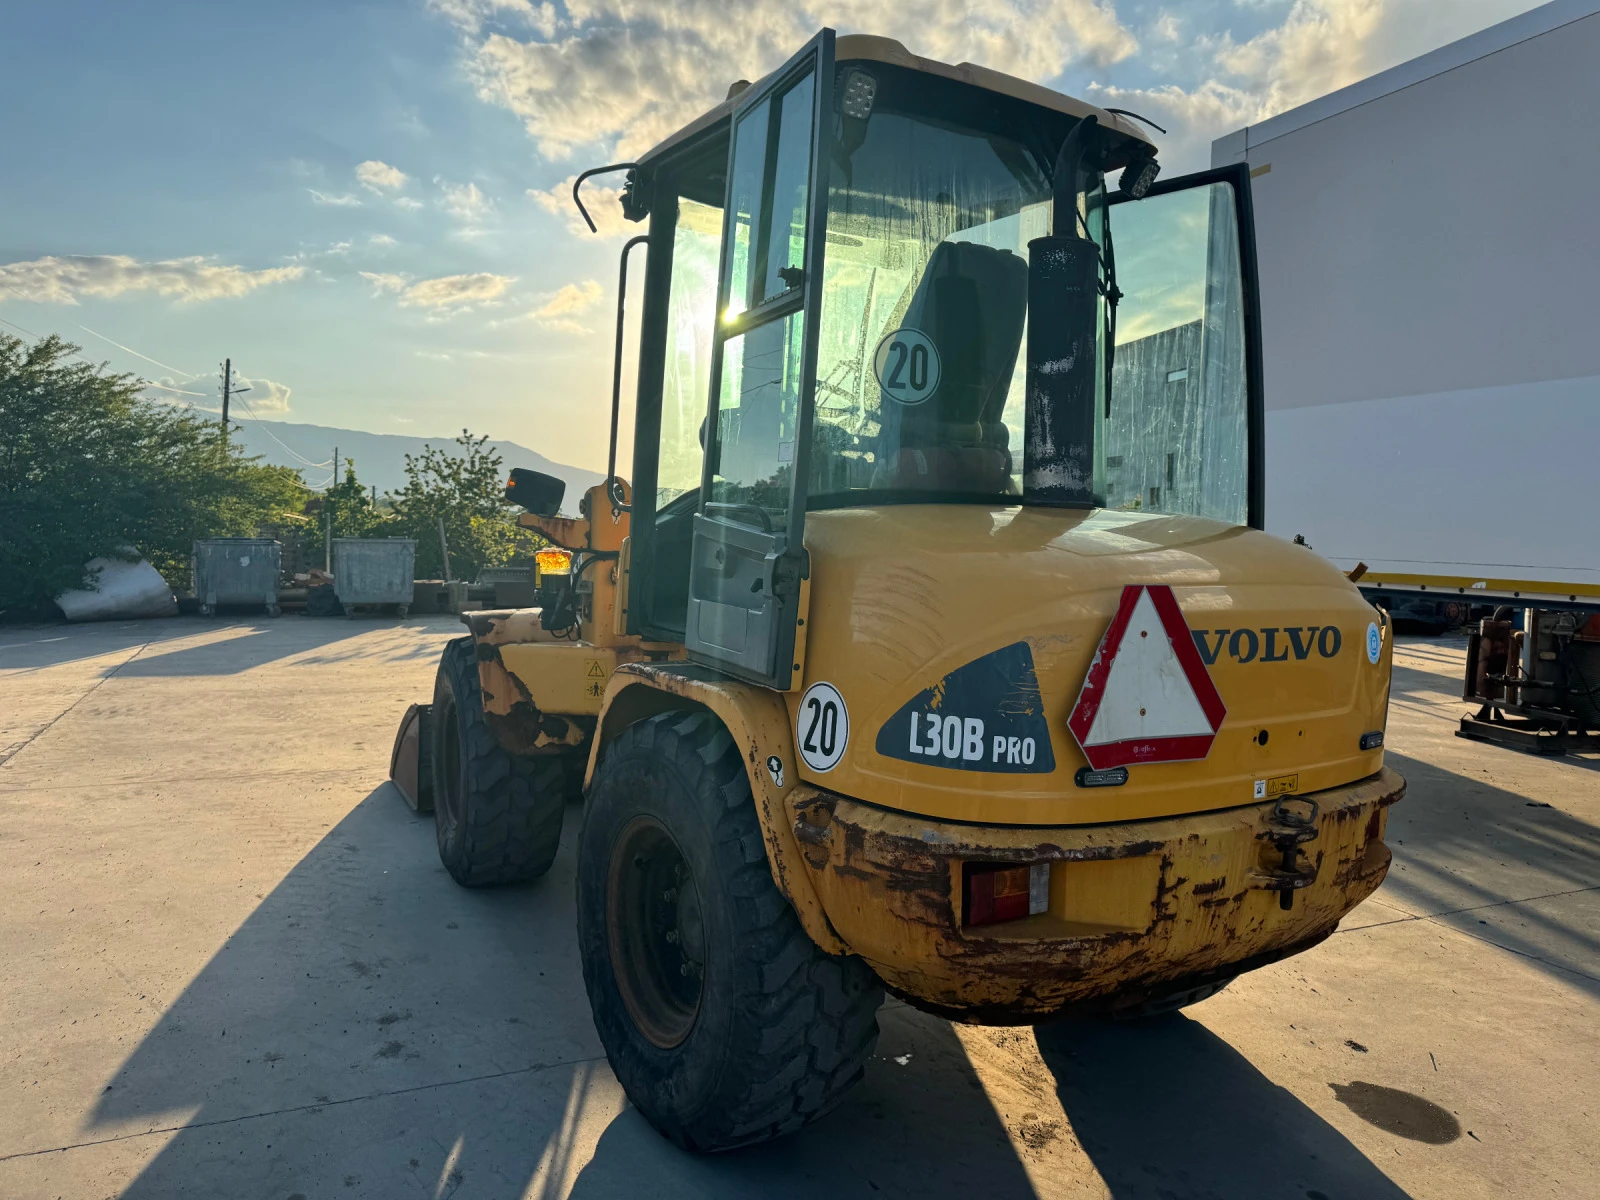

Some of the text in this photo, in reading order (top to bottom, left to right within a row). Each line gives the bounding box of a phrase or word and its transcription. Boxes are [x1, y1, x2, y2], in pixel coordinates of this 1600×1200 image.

[887, 341, 928, 391] 20
[1191, 625, 1342, 665] VOLVO
[803, 697, 838, 756] 20
[909, 711, 1036, 765] L30B PRO
